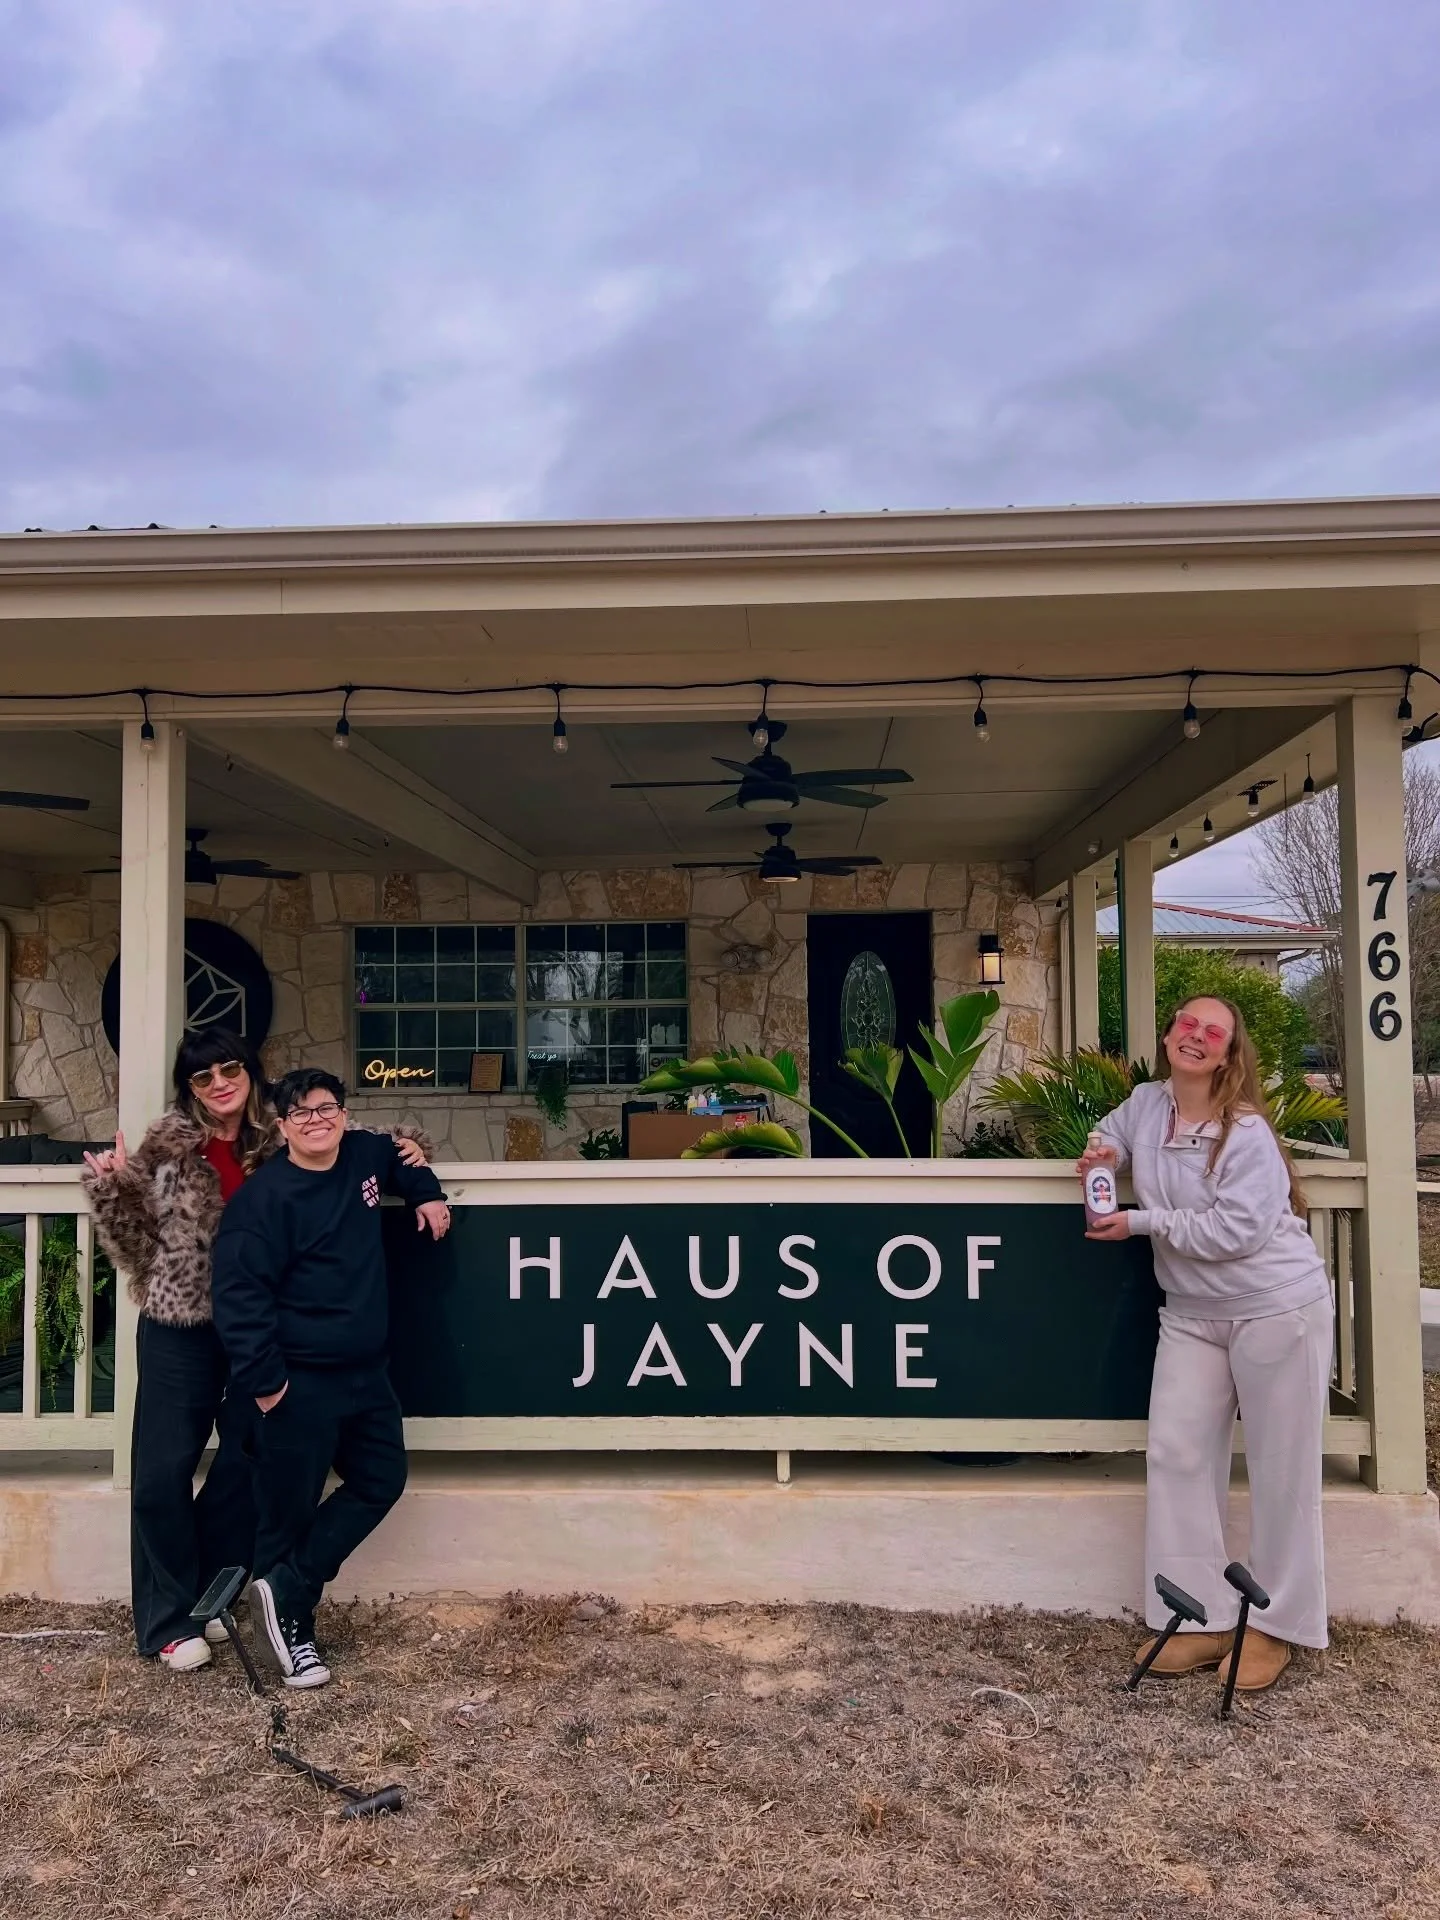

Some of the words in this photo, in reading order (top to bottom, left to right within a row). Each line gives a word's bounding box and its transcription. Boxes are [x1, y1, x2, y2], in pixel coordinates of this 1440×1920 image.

[1367, 870, 1403, 1042] 766
[365, 1059, 435, 1088] Open
[509, 1234, 820, 1300] HAUS
[876, 1234, 1002, 1300] OF
[572, 1321, 938, 1389] JAYNE
